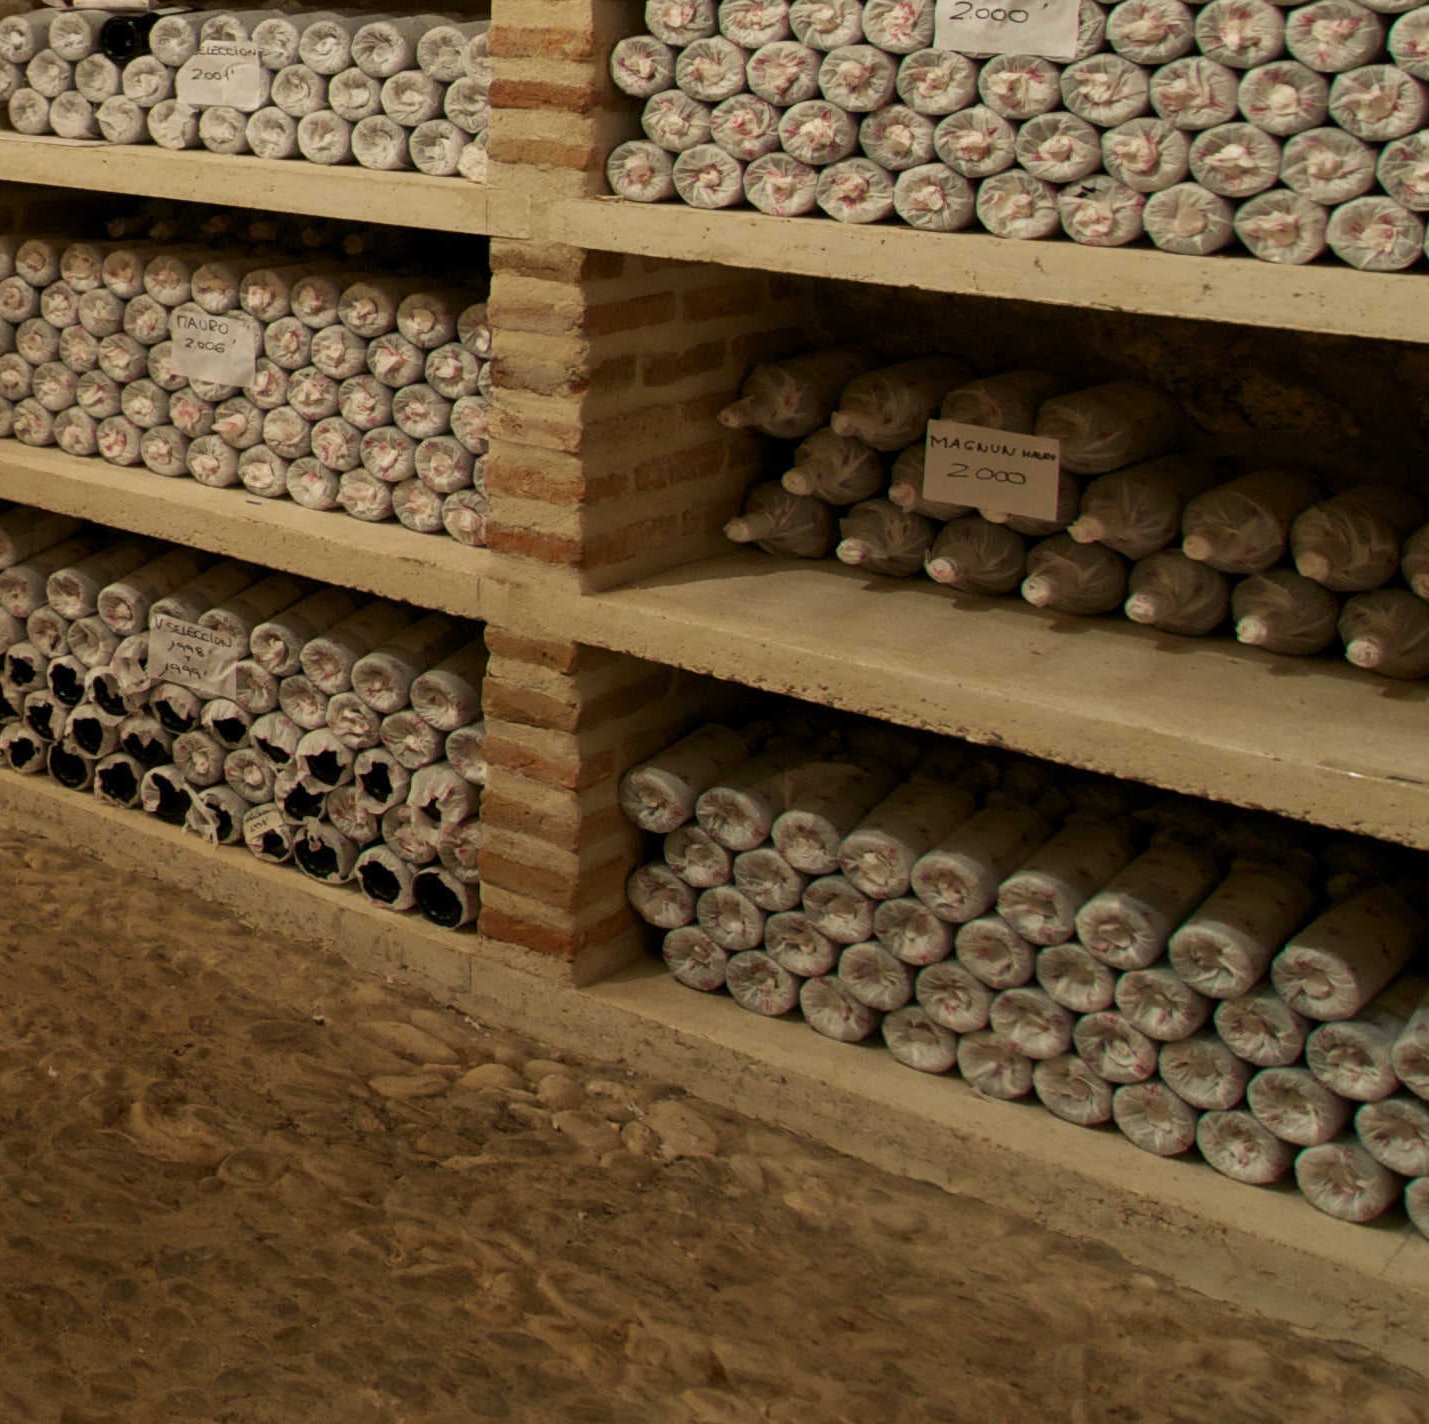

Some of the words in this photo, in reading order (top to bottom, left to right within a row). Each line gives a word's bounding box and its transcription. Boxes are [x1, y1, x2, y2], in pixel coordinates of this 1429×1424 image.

[197, 45, 257, 57] ELECCION
[176, 315, 229, 335] MAURO
[947, 462, 1027, 485] 2000
